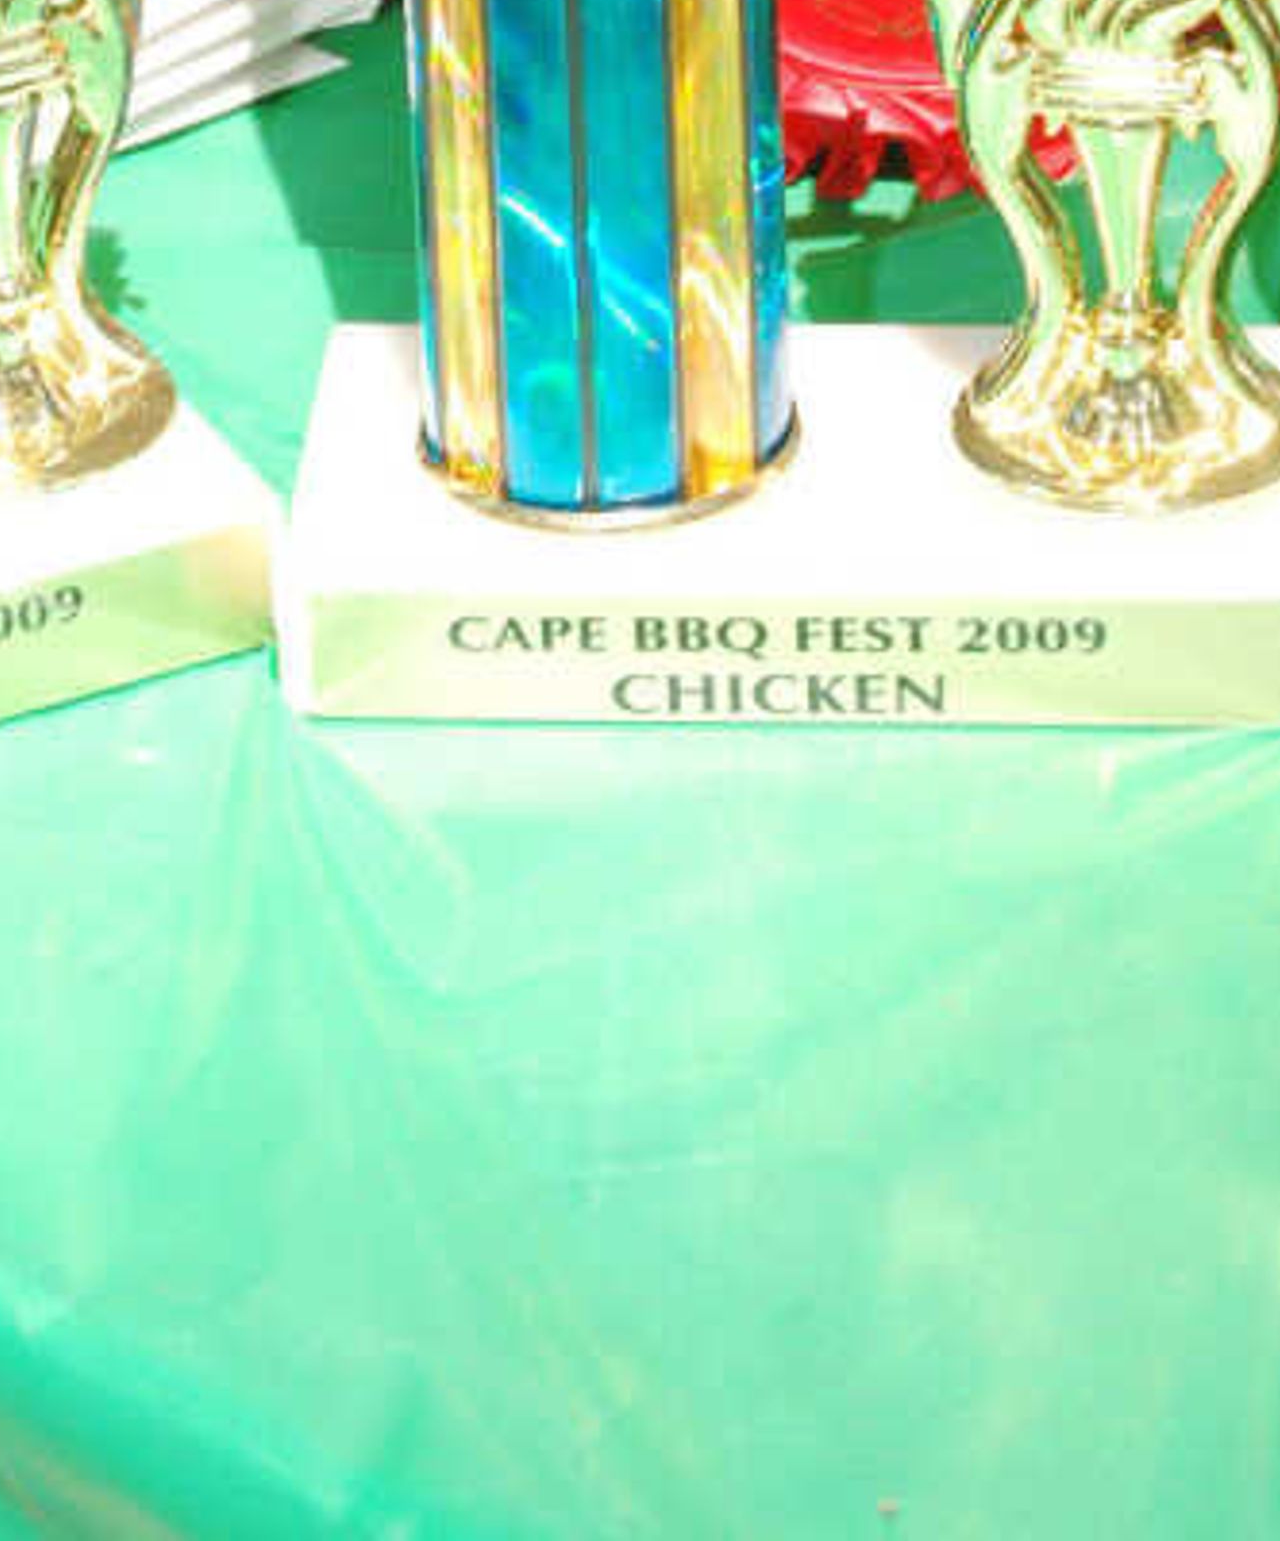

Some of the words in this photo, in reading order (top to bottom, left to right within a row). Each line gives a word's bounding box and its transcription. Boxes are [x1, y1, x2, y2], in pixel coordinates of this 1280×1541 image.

[448, 614, 607, 653] CAPE
[633, 614, 768, 658] BBQ
[795, 616, 932, 653] FEST
[957, 616, 1108, 655] 2009
[611, 671, 949, 716] CHICKEN
